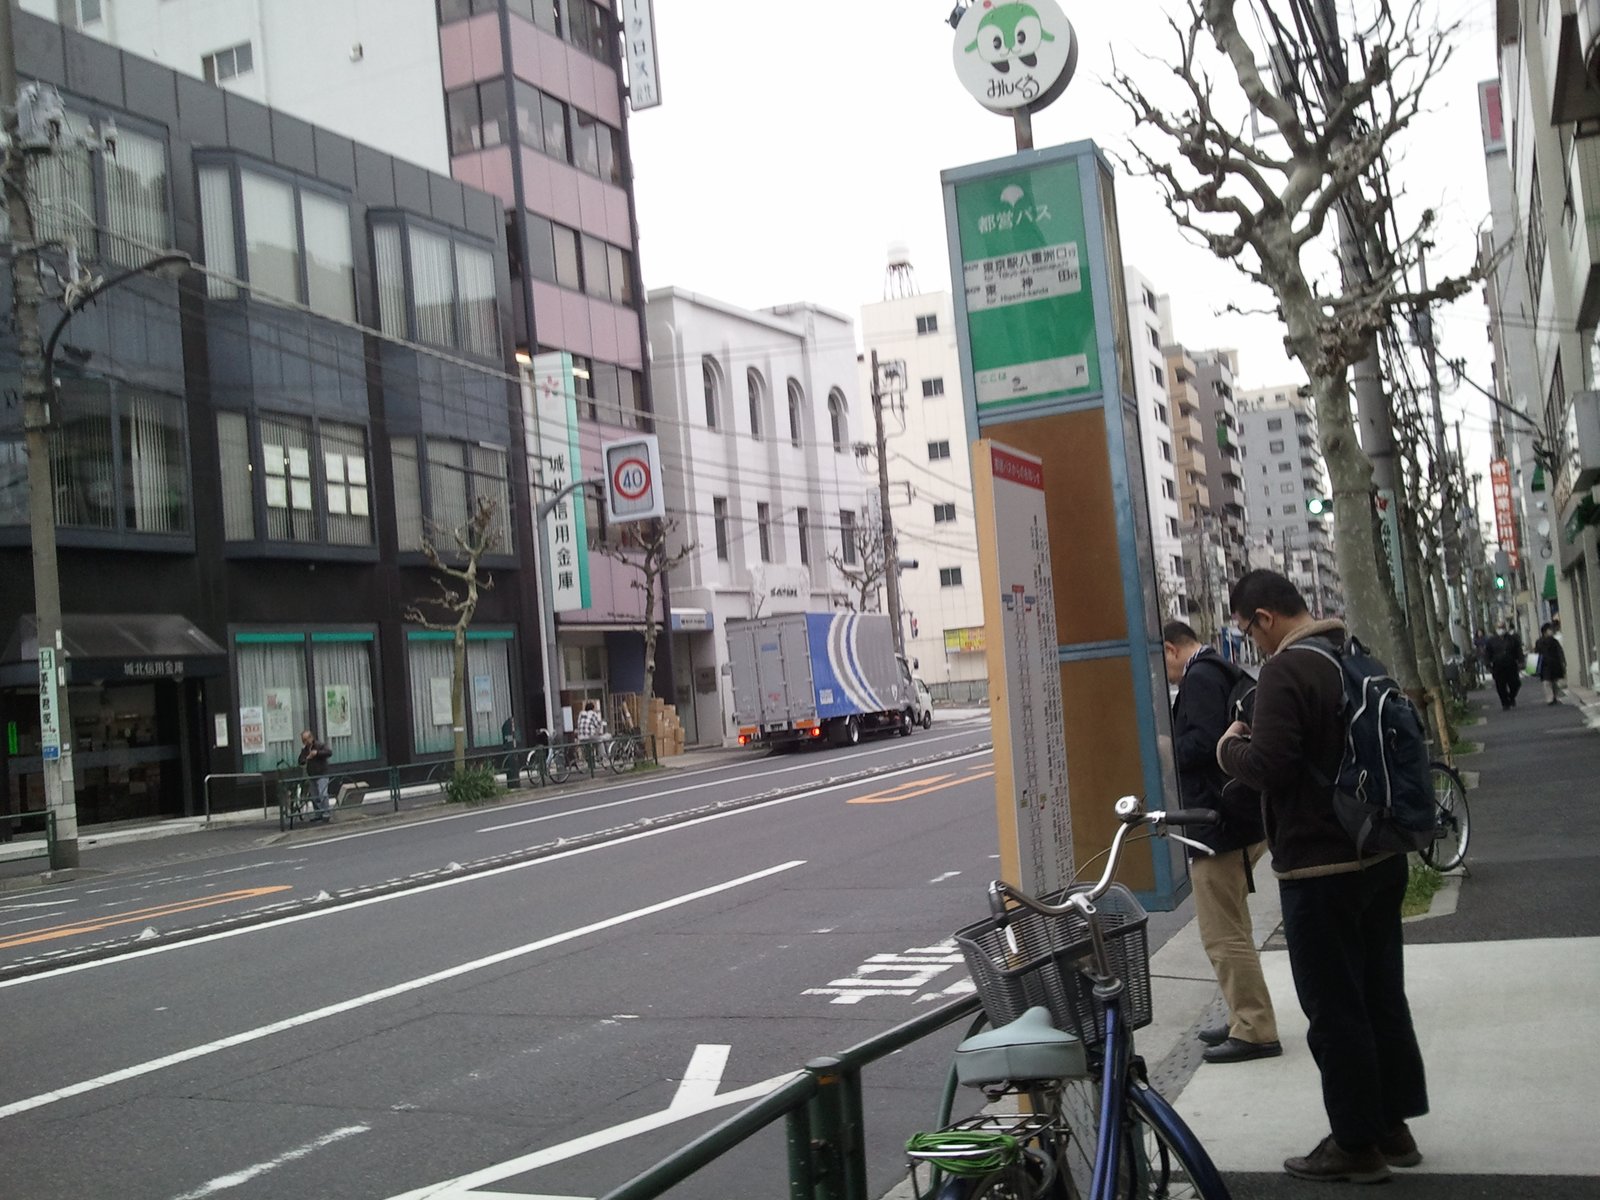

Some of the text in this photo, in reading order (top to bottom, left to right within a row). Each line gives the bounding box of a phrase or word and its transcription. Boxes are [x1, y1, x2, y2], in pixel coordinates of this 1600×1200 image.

[978, 205, 1052, 234] 都営バス
[622, 469, 643, 490] 40
[549, 453, 575, 591] 城北信用金庫
[123, 660, 185, 677] 城北信用金庫
